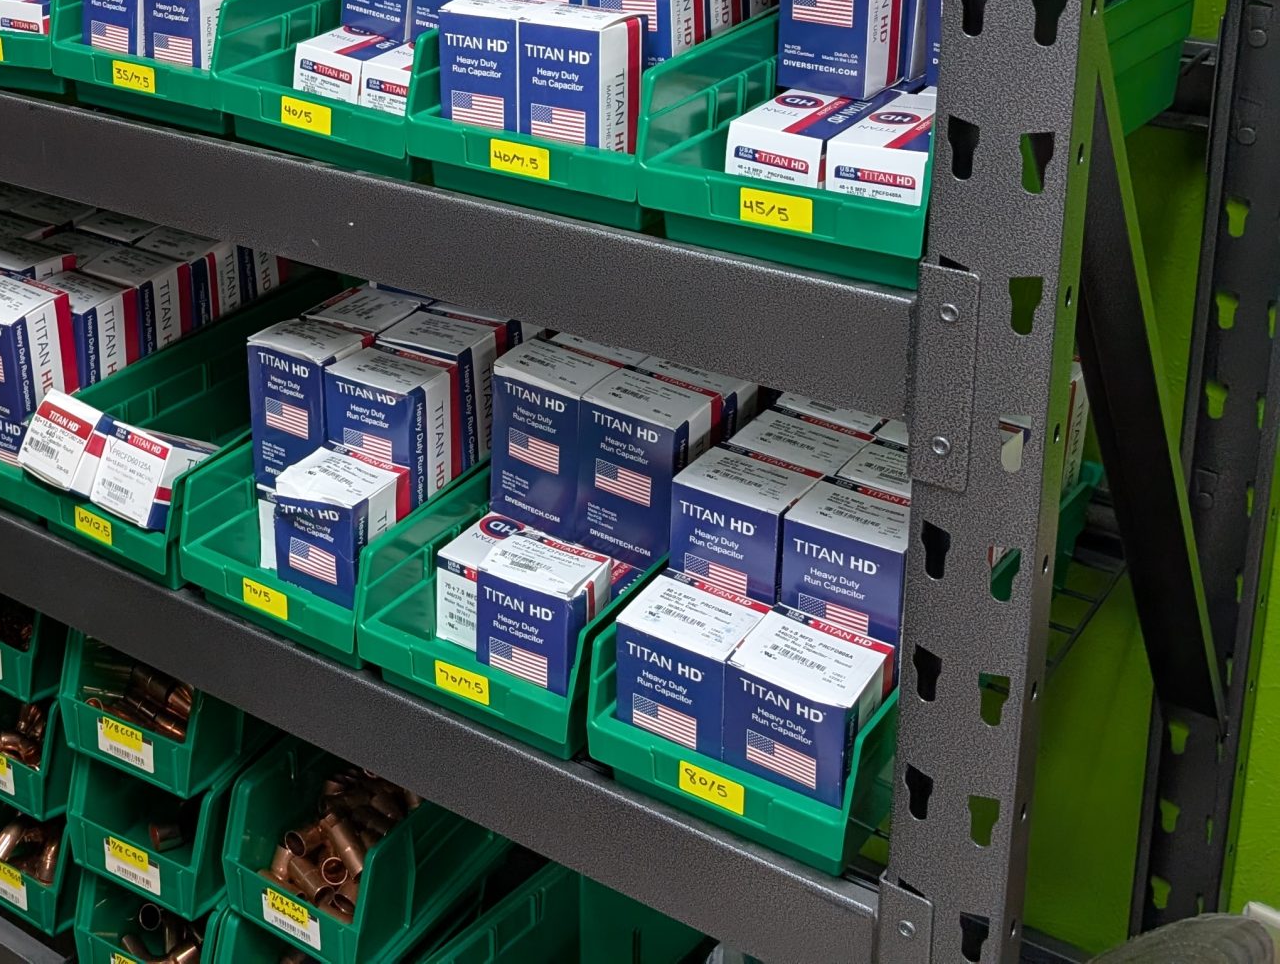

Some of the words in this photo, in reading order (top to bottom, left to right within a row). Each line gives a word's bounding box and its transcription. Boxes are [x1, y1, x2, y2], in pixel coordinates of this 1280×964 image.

[346, 2, 401, 23] DIVERSITECH.COM
[444, 33, 485, 51] TITAN
[487, 37, 508, 53] HD
[525, 43, 566, 61] TITAN
[568, 49, 590, 64] HD
[114, 66, 150, 88] 35/7.5
[783, 59, 858, 77] DIVERSITECH.COM
[284, 104, 313, 124] 40/5
[493, 148, 539, 171] 40/7.5
[739, 146, 754, 155] USA
[760, 152, 790, 168] TITAN
[791, 159, 807, 170] HD
[863, 170, 895, 185] TITAN
[896, 175, 914, 187] HD
[743, 196, 791, 223] 45/5
[33, 313, 50, 367] TITAN
[336, 381, 374, 401] TITAN
[376, 392, 396, 406] HD
[504, 381, 542, 406] TITAN
[544, 396, 565, 413] HD
[504, 494, 561, 524] DIVERSITECH.COM
[680, 500, 726, 529] TITAN
[729, 516, 756, 536] HD
[793, 538, 845, 567] TITAN
[849, 556, 878, 575] HD
[817, 623, 853, 641] TITAN
[854, 636, 872, 647] HD
[626, 642, 673, 672] TITAN
[677, 661, 703, 682] HD
[439, 665, 484, 695] 70/7.5
[636, 676, 656, 692] Run
[656, 682, 694, 706] Capacitor
[641, 668, 666, 687] Heavy
[666, 677, 688, 694] Duty
[683, 766, 729, 800] 80/5
